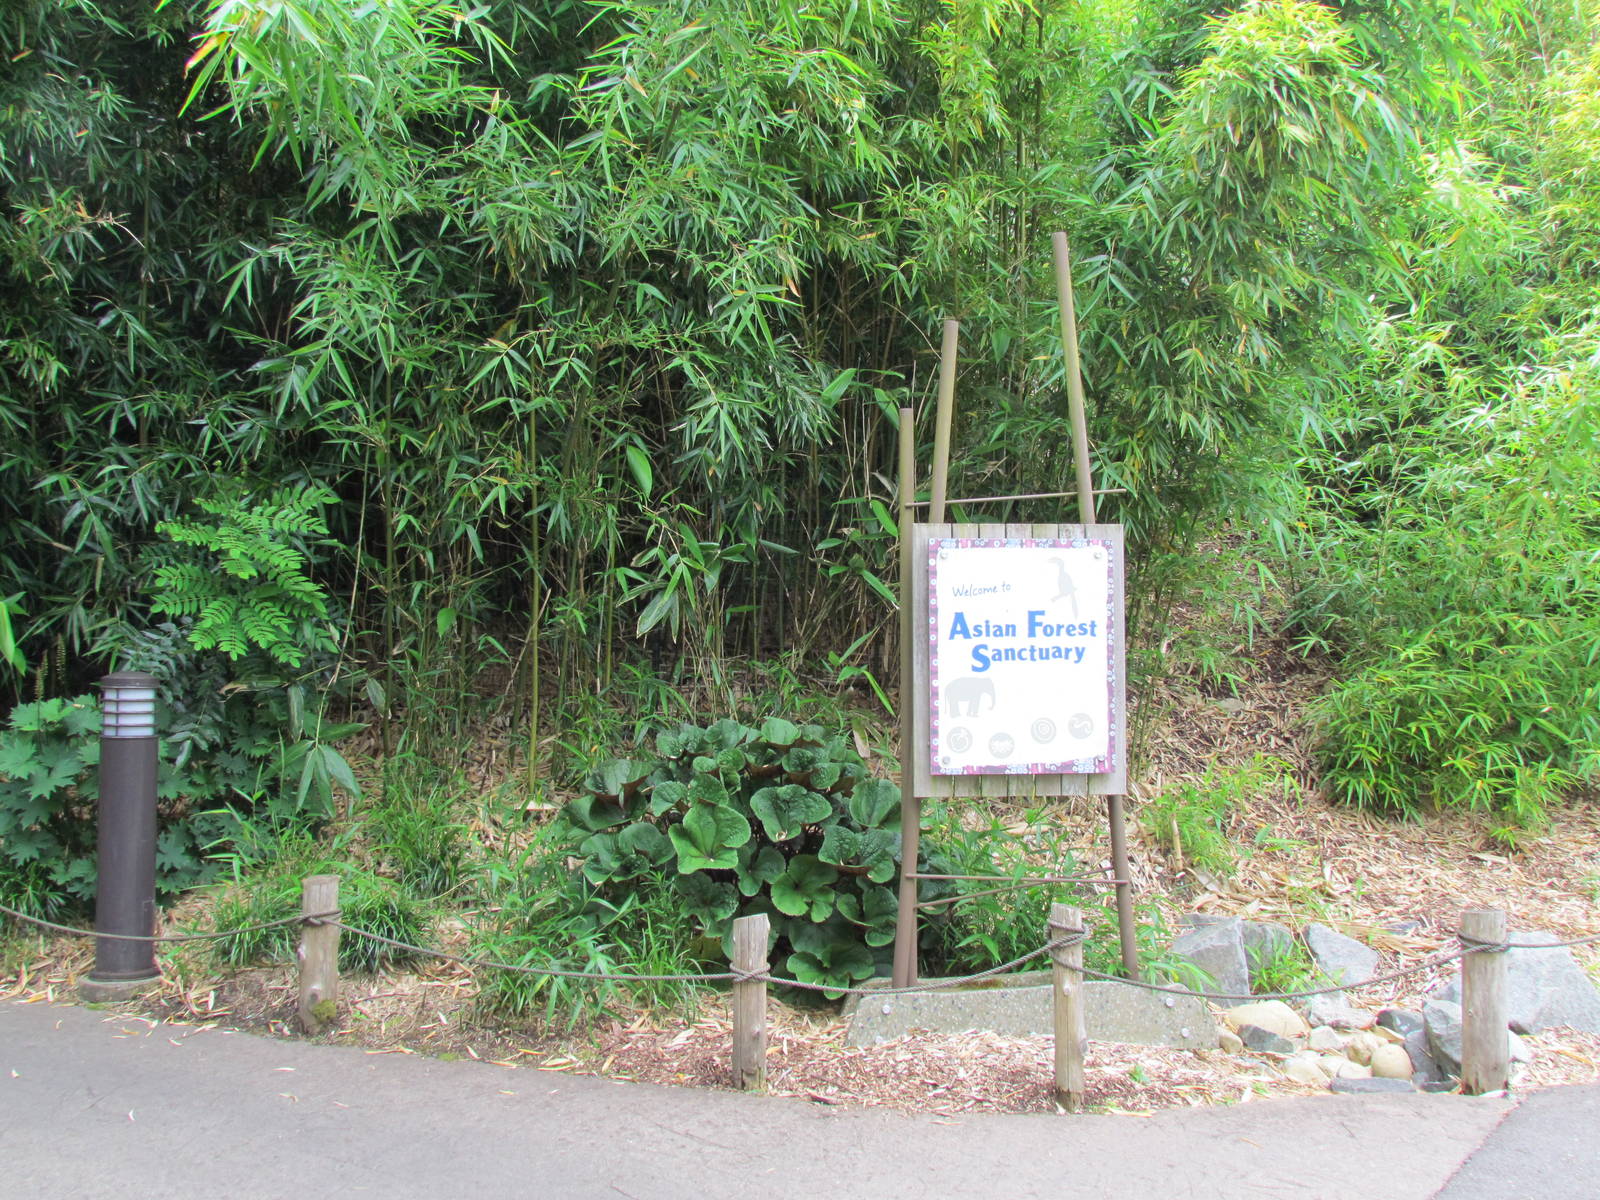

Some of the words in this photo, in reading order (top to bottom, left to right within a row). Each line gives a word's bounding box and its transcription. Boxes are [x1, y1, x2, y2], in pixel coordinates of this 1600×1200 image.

[952, 583, 998, 598] Welcome
[1001, 580, 1012, 592] to
[949, 611, 1017, 640] Asian
[1027, 610, 1097, 638] Forest
[971, 643, 1086, 673] Sanctuary
